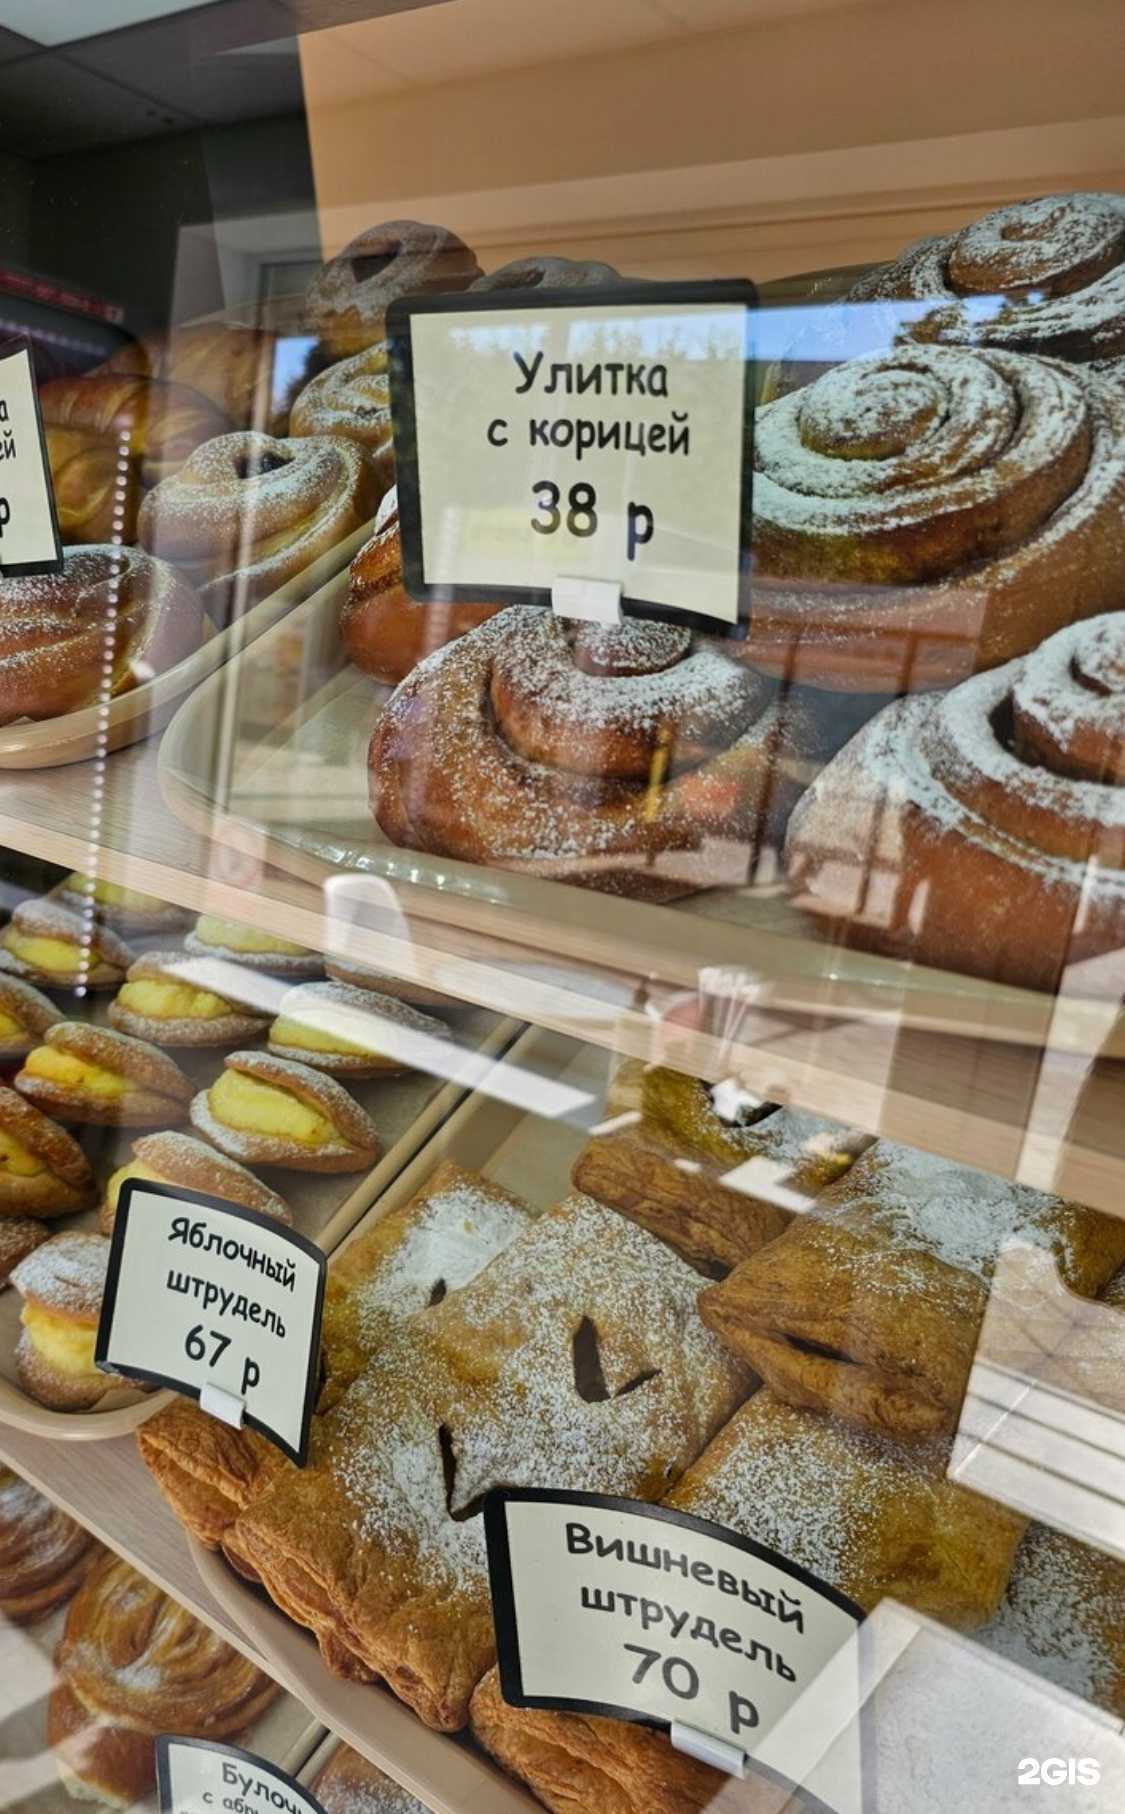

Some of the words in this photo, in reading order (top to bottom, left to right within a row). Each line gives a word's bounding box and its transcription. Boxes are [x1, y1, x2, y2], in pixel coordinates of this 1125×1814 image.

[512, 351, 668, 397] Улитка
[487, 419, 508, 447] с
[529, 410, 690, 461] корицей
[531, 480, 598, 537] 38
[627, 501, 654, 561] р
[168, 1217, 296, 1292] Яблочный
[166, 1270, 285, 1338] штрудель
[185, 1324, 232, 1367] 67
[241, 1357, 260, 1395] р
[565, 1522, 804, 1634] Вишневый
[580, 1586, 796, 1682] штрудель
[623, 1643, 699, 1699] 70
[728, 1690, 759, 1734] р
[202, 1791, 214, 1804] с
[222, 1762, 302, 1814] Булоч
